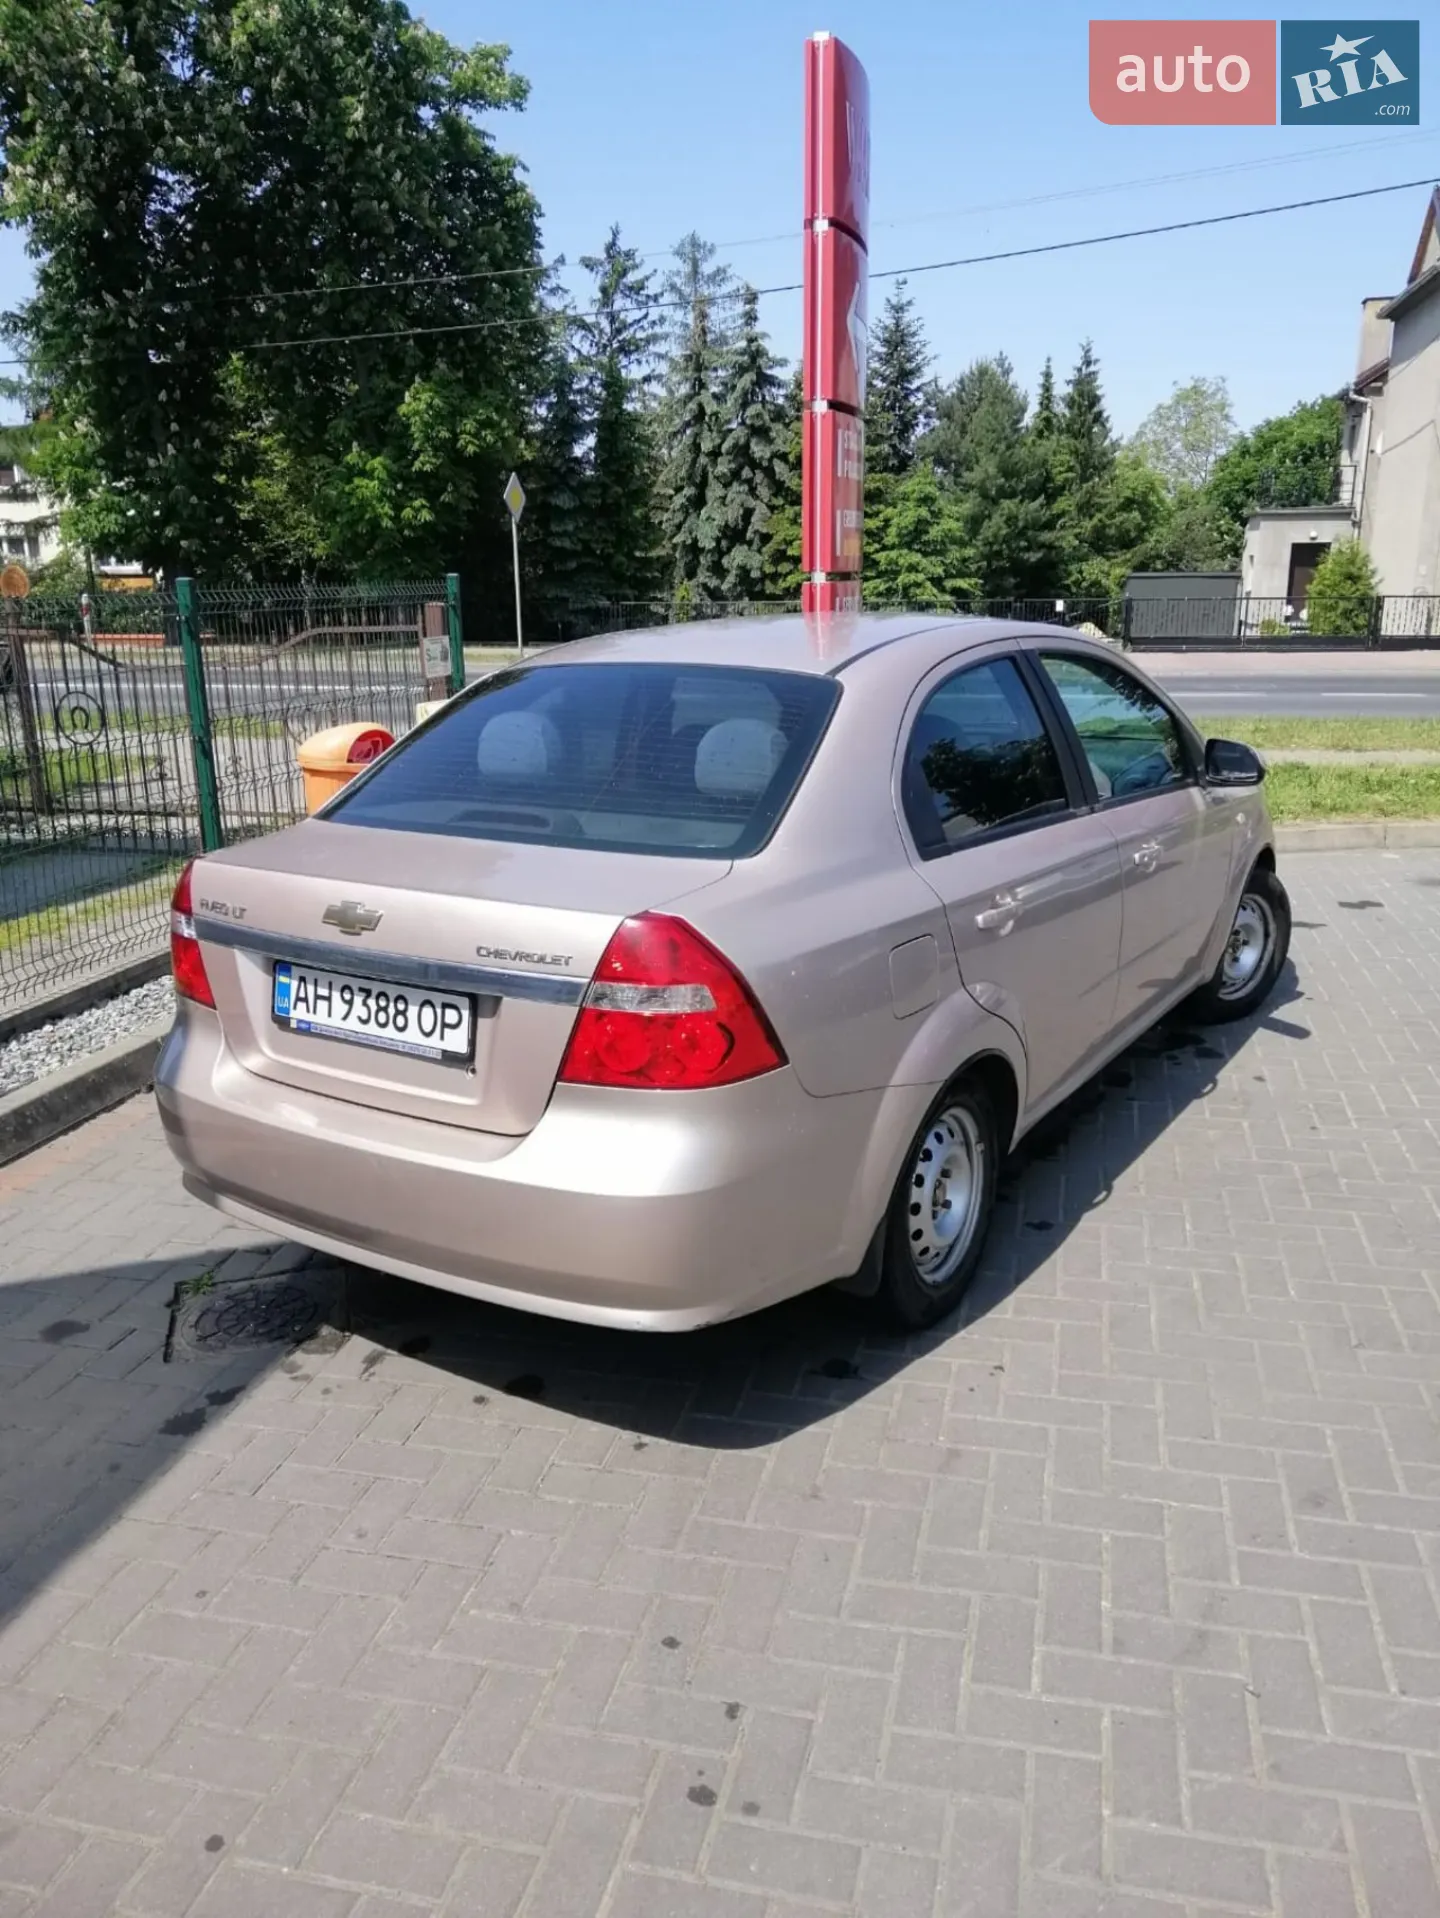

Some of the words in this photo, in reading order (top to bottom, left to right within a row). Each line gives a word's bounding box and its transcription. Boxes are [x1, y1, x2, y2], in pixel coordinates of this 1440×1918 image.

[232, 905, 247, 919] LT
[476, 945, 573, 966] CHEVROLET
[277, 996, 289, 1008] UA
[293, 976, 333, 1018] AH
[340, 984, 409, 1033] 9388
[417, 999, 463, 1041] OP
